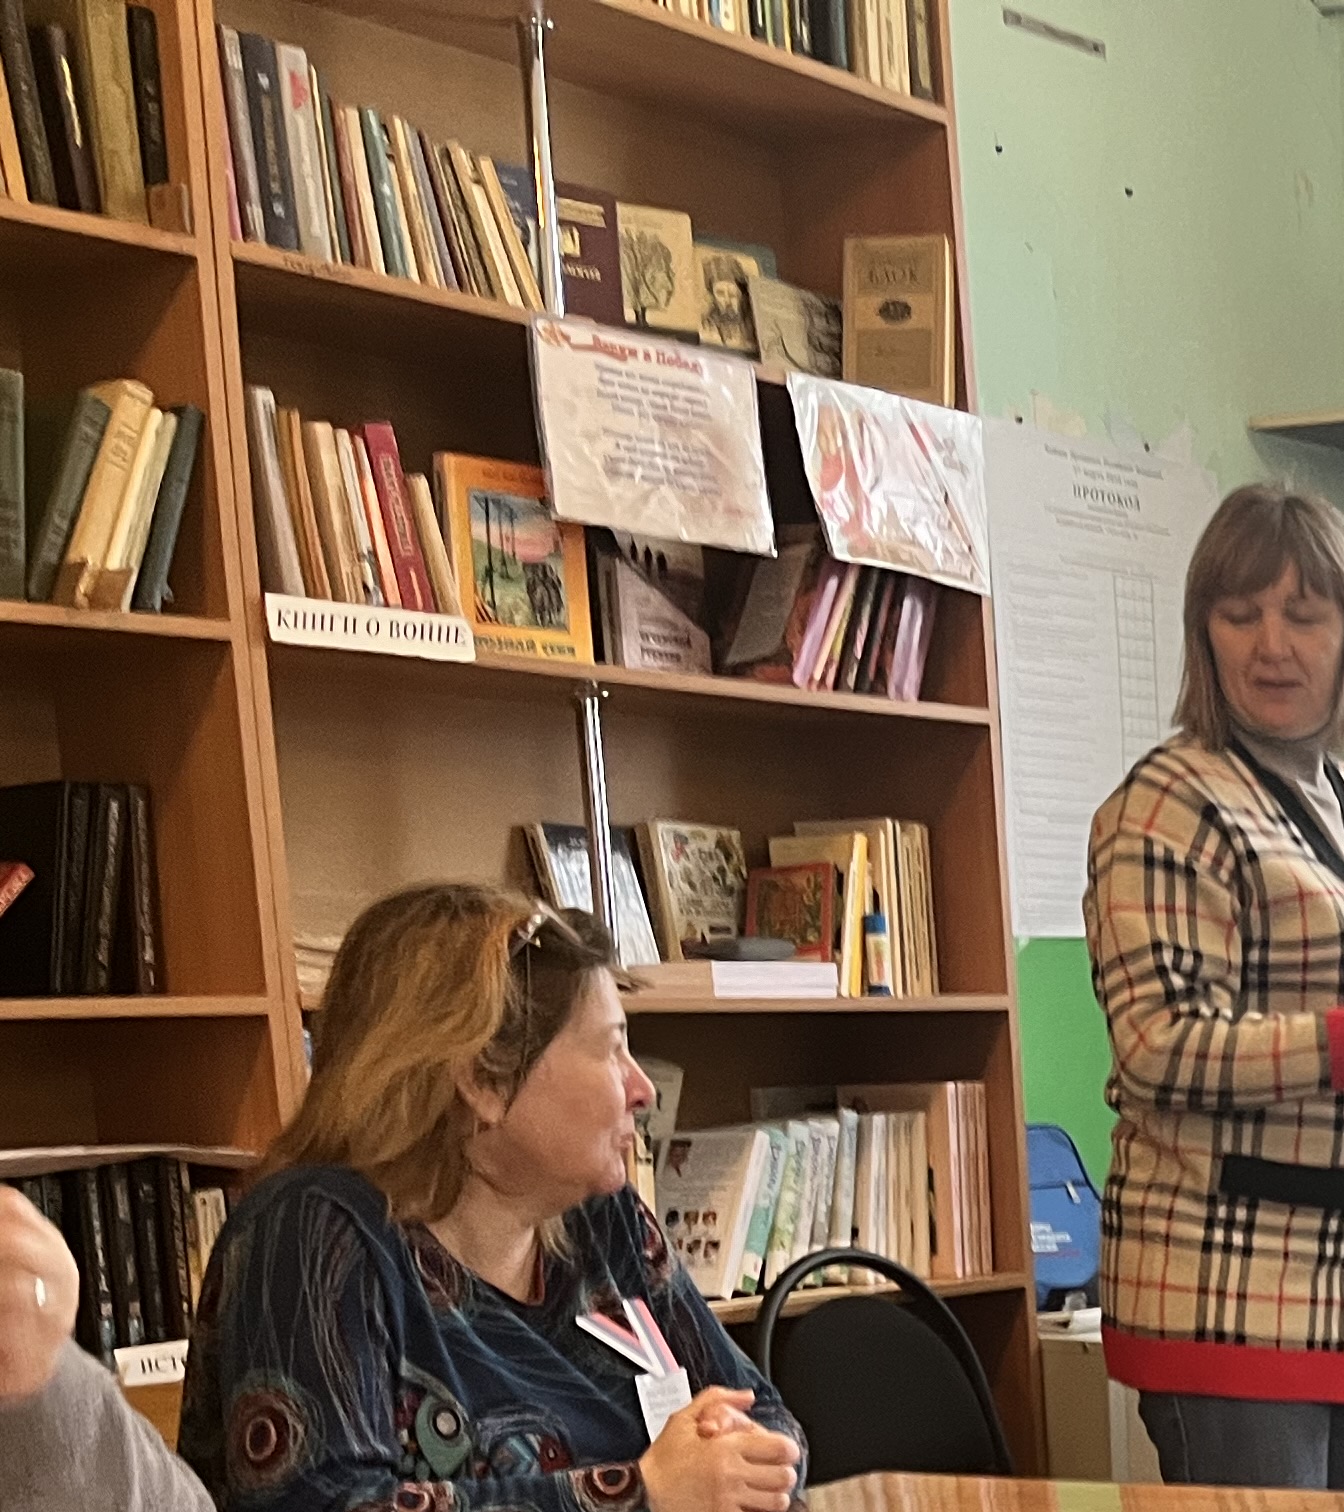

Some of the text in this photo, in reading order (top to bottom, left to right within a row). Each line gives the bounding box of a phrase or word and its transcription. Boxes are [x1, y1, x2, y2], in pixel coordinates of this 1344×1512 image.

[1072, 483, 1141, 512] ПРОТОКОЛ
[278, 608, 357, 635] КНИГИ
[366, 617, 380, 638] О
[389, 618, 468, 648] ВОЙНЕ
